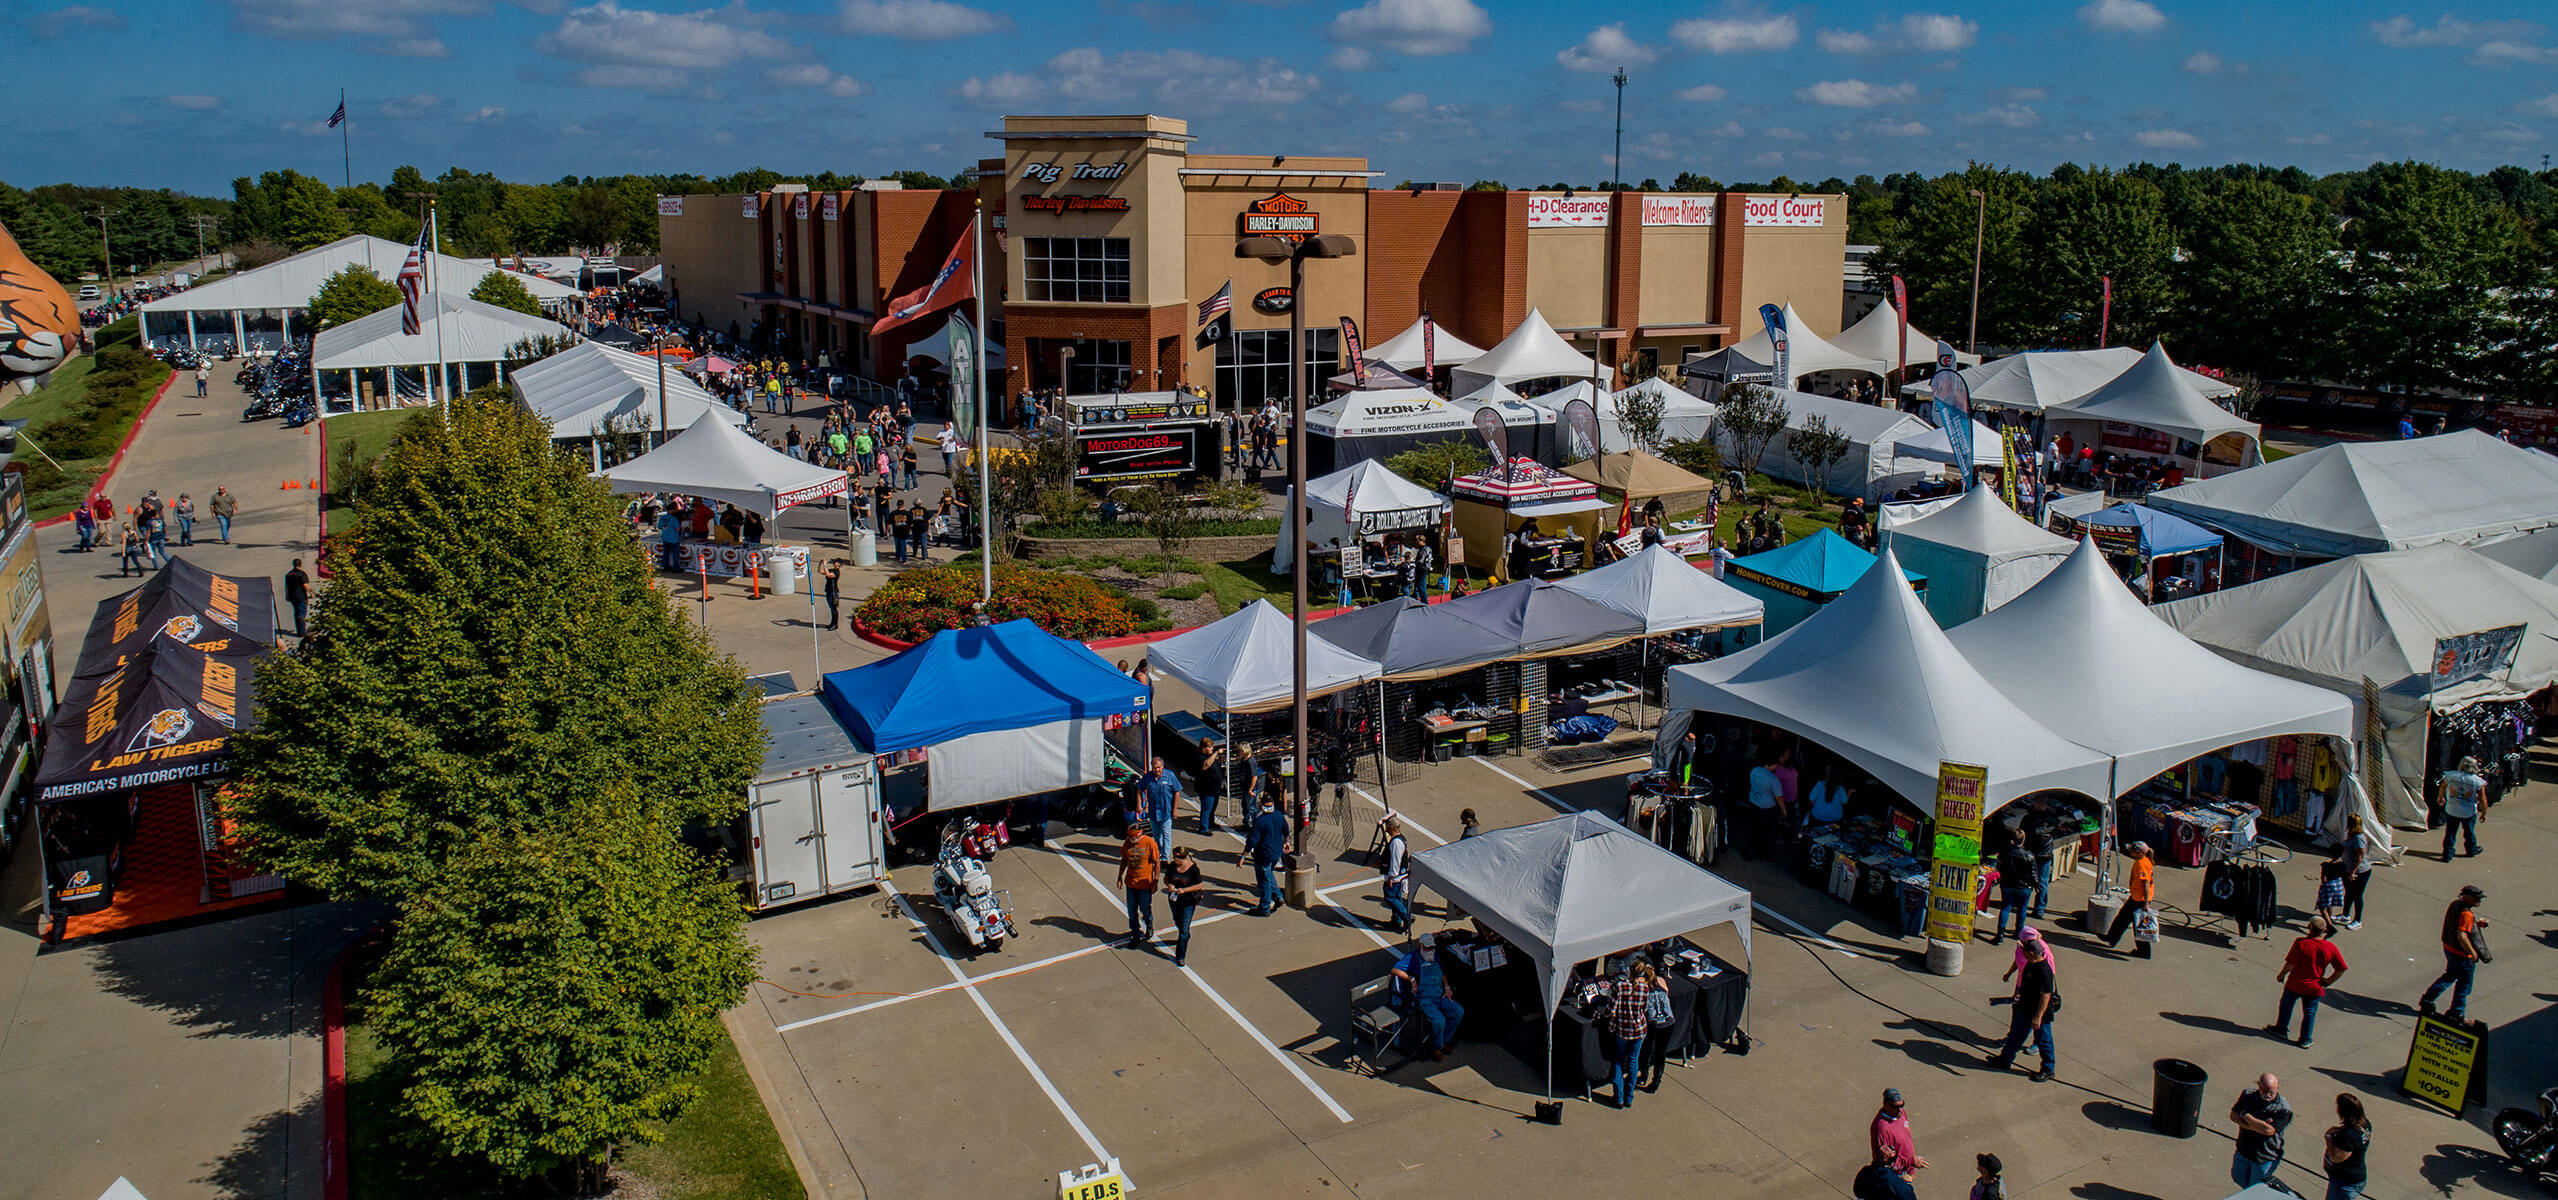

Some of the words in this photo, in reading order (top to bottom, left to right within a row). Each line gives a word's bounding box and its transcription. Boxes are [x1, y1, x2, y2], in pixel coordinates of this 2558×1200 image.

[1022, 163, 1061, 183] Pig
[1072, 163, 1125, 179] Trail
[1264, 198, 1299, 213] MOTOR
[1550, 199, 1608, 214] Clearance
[1644, 200, 1680, 224] Welcome
[1681, 199, 1706, 224] Riders
[1783, 199, 1823, 218] Court
[1249, 217, 1314, 231] HARLEY-DAVIDSON
[952, 338, 972, 404] ATM
[1365, 399, 1432, 416] VIZON-X
[1361, 426, 1376, 434] FINE
[1378, 424, 1421, 433] MOTORCYCLE
[1423, 420, 1465, 430] ACCESSORIES
[776, 476, 846, 510] INFORMATION
[1520, 491, 1551, 501] MOTORCYCLE
[1552, 489, 1575, 498] ACCIDENT
[1575, 487, 1596, 495] LAWYERS
[1377, 511, 1400, 530] ROLLING
[1401, 508, 1428, 529] THUNDER,
[1736, 566, 1808, 598] HONNEYCOVER.COM
[89, 750, 147, 772] LAW
[149, 737, 226, 762] TIGERS
[41, 776, 118, 800] AMERICA'S
[120, 763, 209, 788] MOTORCYCLE
[1944, 775, 1980, 799] WELCOME
[1942, 798, 1976, 821] BIKERS
[1938, 863, 1970, 892] EVENT
[57, 887, 74, 898] LAW
[76, 883, 103, 894] TIGERS
[1934, 896, 1970, 916] MERCHANDISE
[2420, 1030, 2441, 1045] BIKE
[2444, 1039, 2472, 1055] WEEK
[2421, 1056, 2441, 1067] WITH
[2443, 1064, 2459, 1075] TIRE
[2419, 1067, 2460, 1087] INSTALLED
